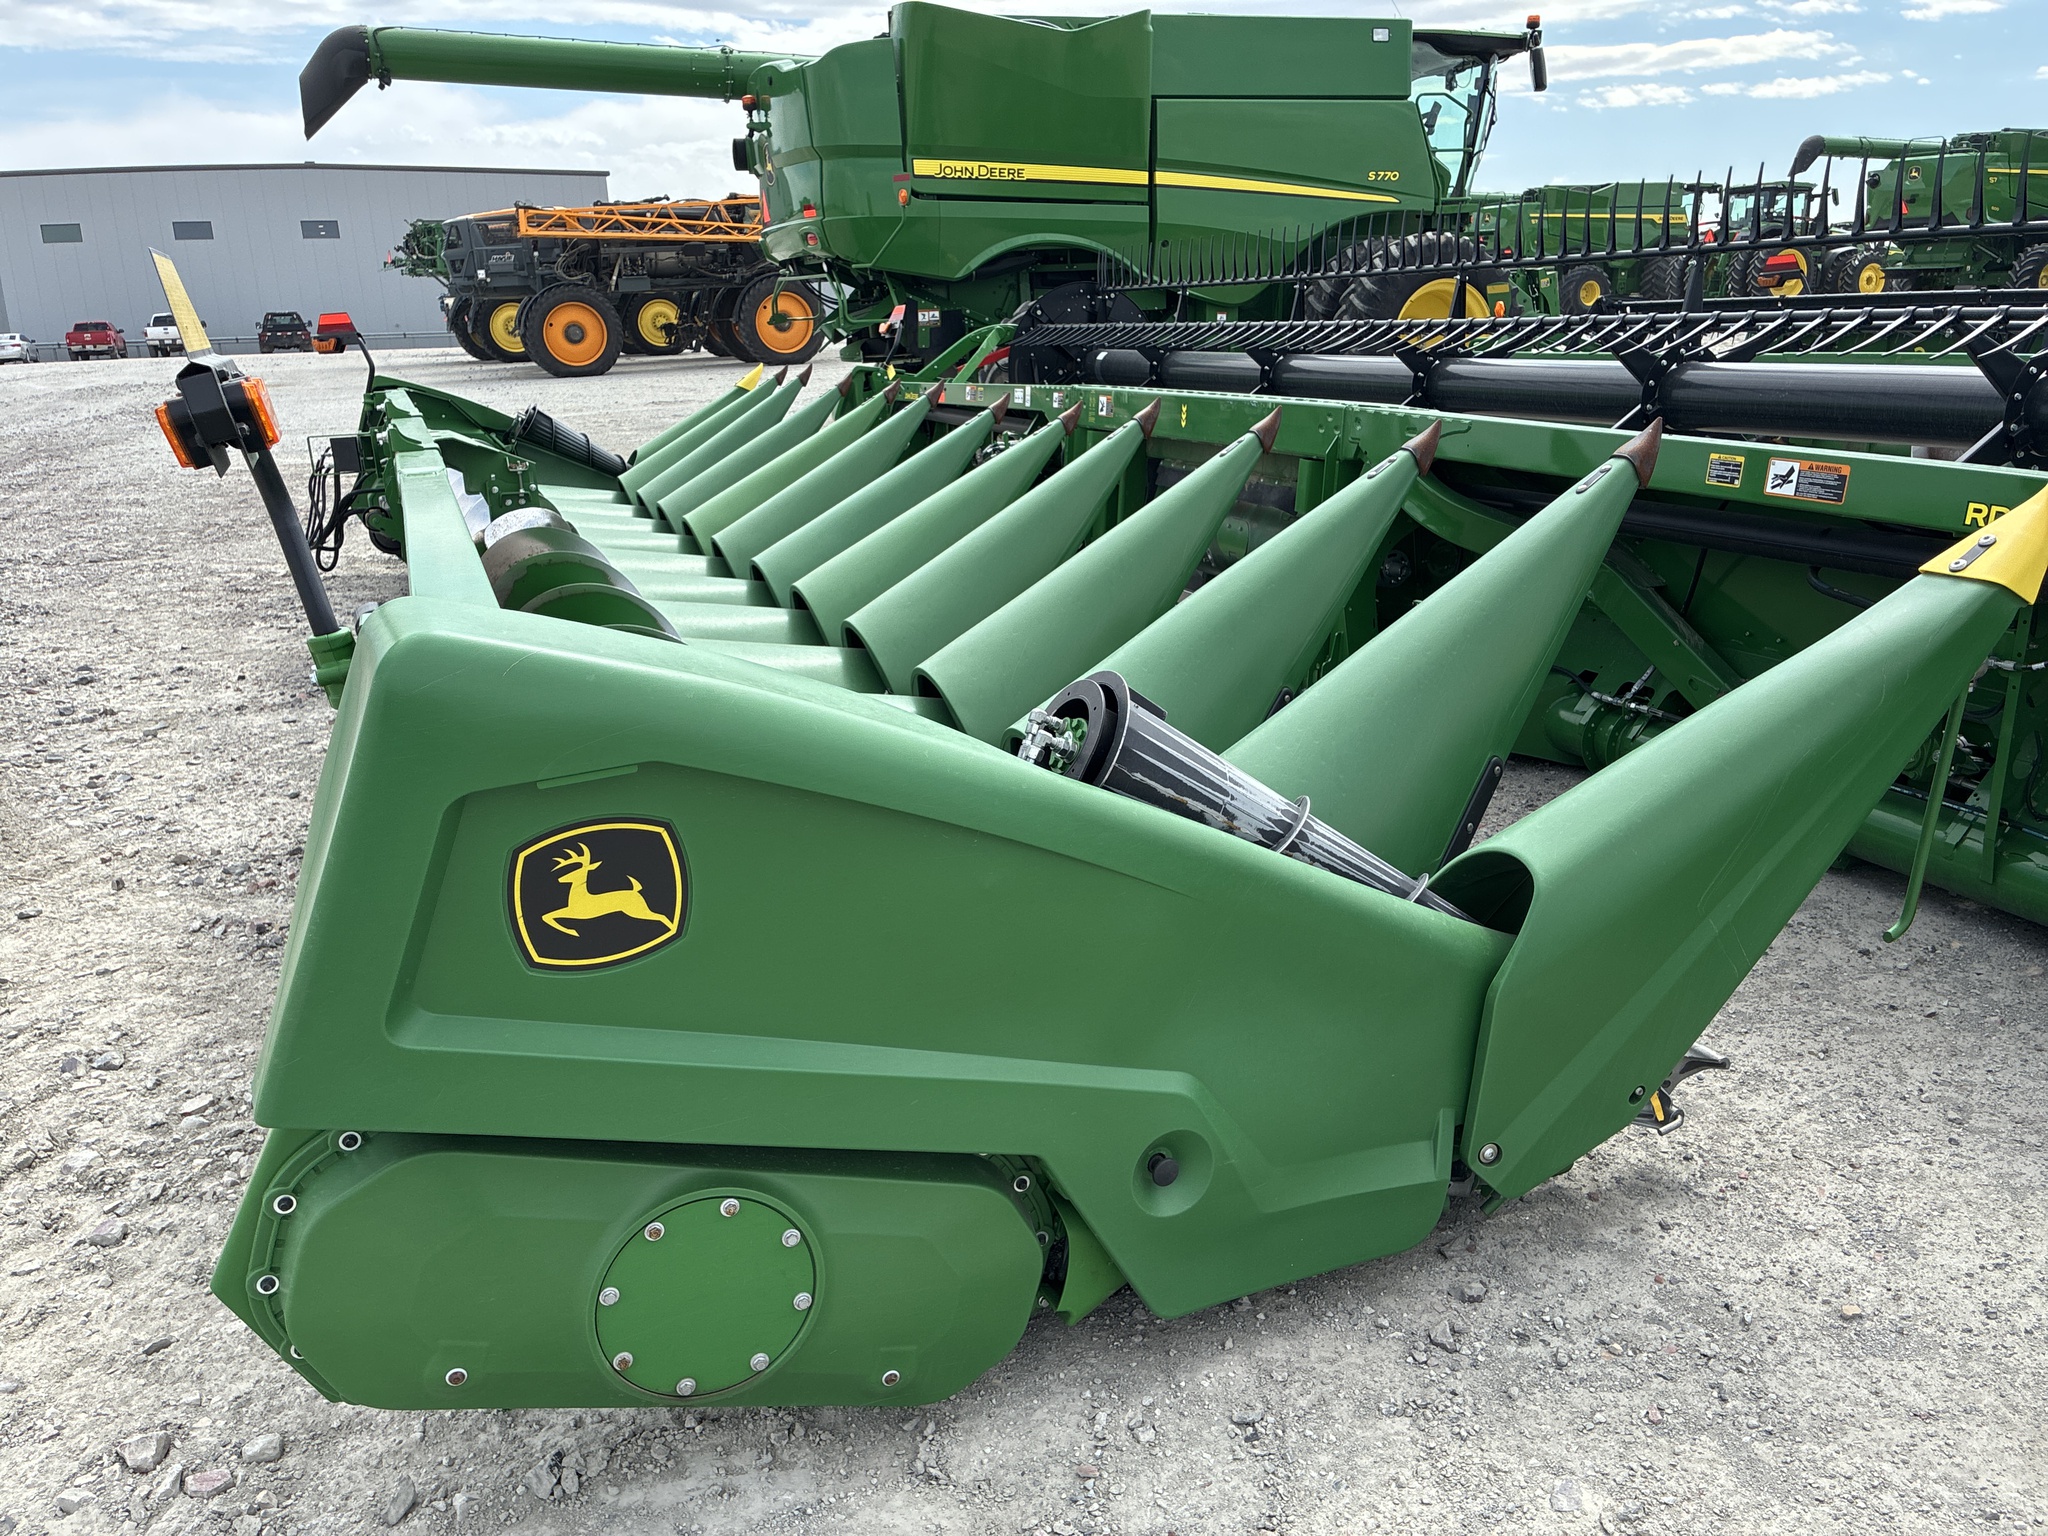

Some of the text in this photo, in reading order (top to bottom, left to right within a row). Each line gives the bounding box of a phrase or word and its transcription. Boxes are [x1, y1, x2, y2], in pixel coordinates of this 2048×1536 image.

[934, 163, 1025, 178] JOHN DEERE
[1814, 464, 1843, 474] WARNING
